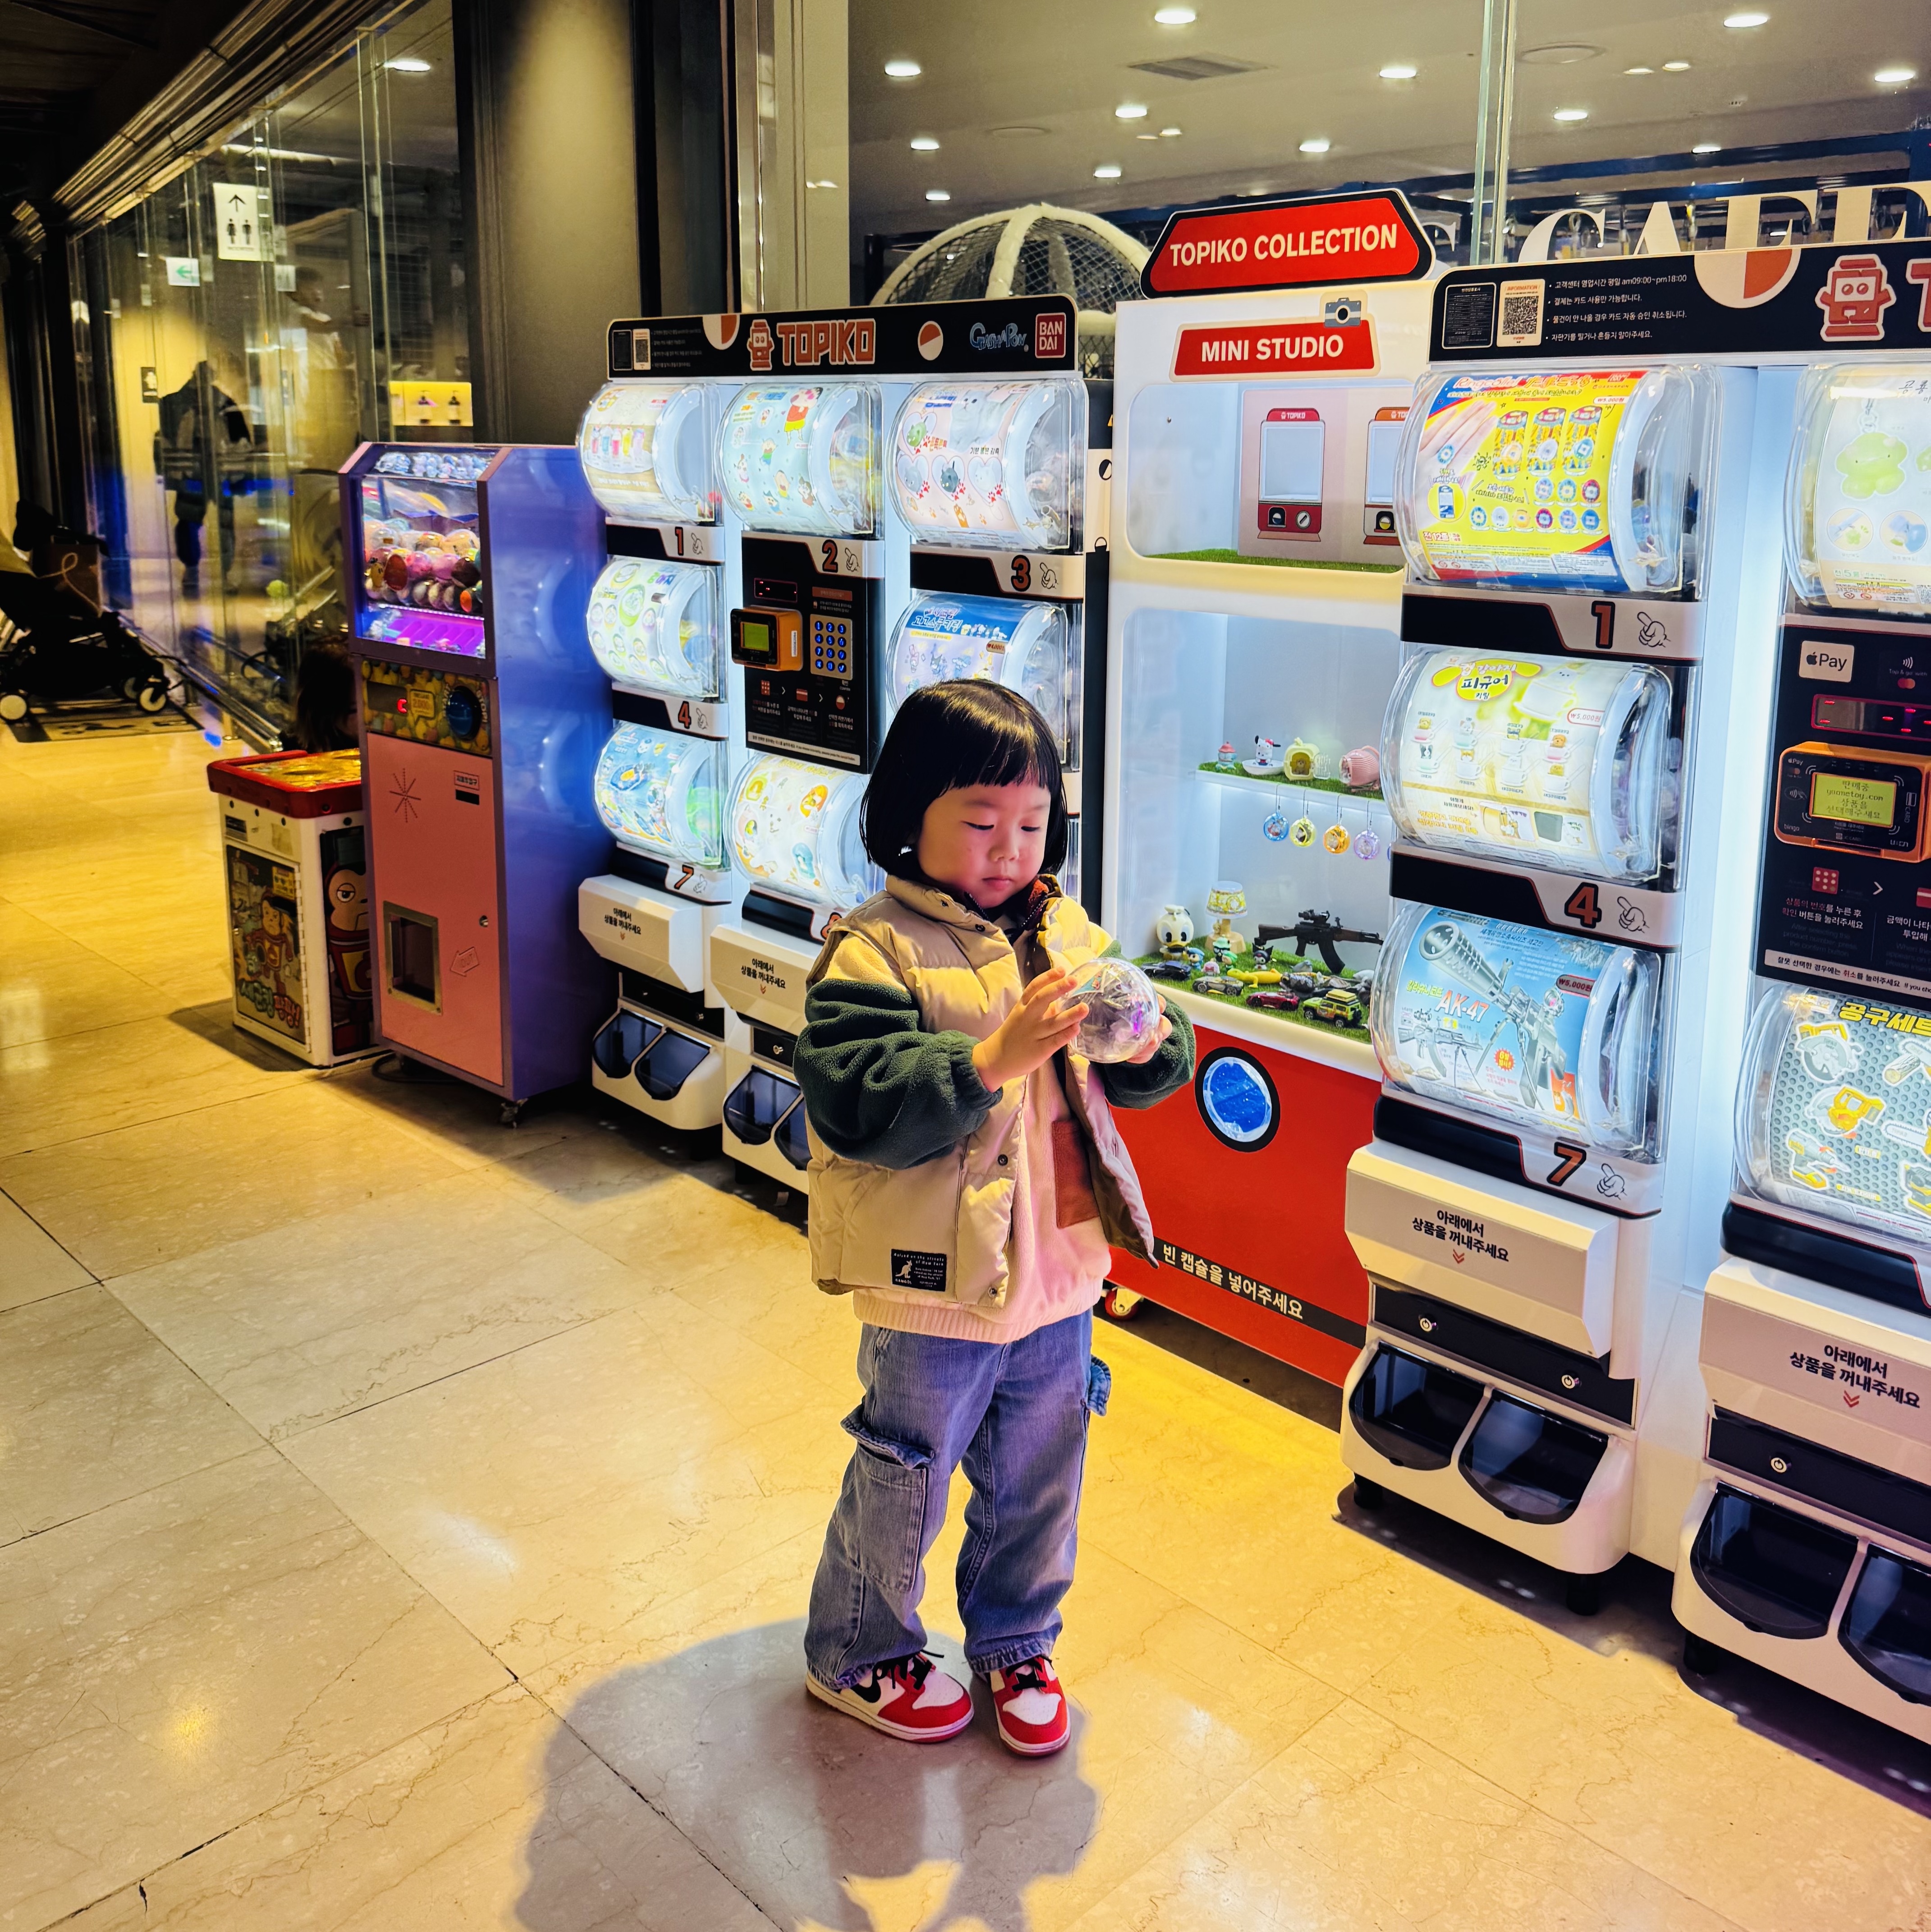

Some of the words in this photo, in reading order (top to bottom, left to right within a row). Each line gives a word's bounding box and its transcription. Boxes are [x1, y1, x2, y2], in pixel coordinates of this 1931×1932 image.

[1170, 237, 1248, 266] TOPIKO
[1254, 223, 1398, 261] COLLECTION
[1555, 280, 1580, 289] 고객센터
[1582, 278, 1606, 288] 영업시간
[1622, 274, 1687, 285] am09:00~pm18:00
[1574, 296, 1586, 304] 카드
[1039, 321, 1063, 335] BAN
[776, 318, 876, 367] TOPIKO
[1039, 336, 1058, 351] DAI
[1202, 339, 1249, 362] MINI
[1256, 335, 1344, 360] STUDIO
[1899, 380, 1928, 394] 공룡
[675, 527, 683, 555] 1
[822, 539, 838, 573] 2
[1011, 555, 1031, 592] 3
[1591, 601, 1615, 649] 1
[1819, 653, 1848, 671] Pay
[1461, 674, 1509, 689] 피규어
[678, 701, 692, 729] 4
[1842, 780, 1870, 792] 판매중
[1827, 805, 1881, 819] 선택해주세요
[1841, 798, 1867, 810] 상품을
[674, 865, 694, 890] 7
[613, 908, 632, 922] 아래에서
[1564, 882, 1602, 929] 4
[1785, 897, 1808, 908] 상품의
[1811, 901, 1834, 913] 번호를
[1836, 905, 1852, 916] 누른
[1853, 909, 1862, 918] 후
[604, 914, 618, 927] 상품을
[619, 919, 641, 935] 꺼내주세요
[1781, 907, 1797, 917] 확인
[1799, 910, 1822, 922] 버튼을
[1824, 915, 1863, 930] 눌러주세요
[1887, 915, 1911, 927] 금액이
[1903, 929, 1928, 941] 투입해
[741, 965, 757, 979] 상품을
[758, 972, 786, 989] 꺼내주세요
[752, 958, 774, 974] 아래에서
[1792, 959, 1812, 970] 선택한
[1814, 964, 1841, 976] 경우에는
[1843, 969, 1863, 981] 취소를
[1865, 973, 1900, 987] 눌러주세요
[1434, 989, 1490, 1023] AK-47
[1839, 1001, 1931, 1037] 공구세트
[1546, 1141, 1587, 1187] 7
[1437, 1210, 1484, 1238] 아래에서
[1412, 1217, 1447, 1240] 상품을
[1449, 1230, 1509, 1262] 꺼내주세요
[1163, 1244, 1176, 1266] 빈
[1180, 1251, 1224, 1286] 캡슐을
[1228, 1271, 1303, 1320] 넣어주세요
[1824, 1345, 1888, 1379] 아래에서
[1789, 1352, 1837, 1381] 상품을
[1839, 1368, 1920, 1409] 꺼내주세요
